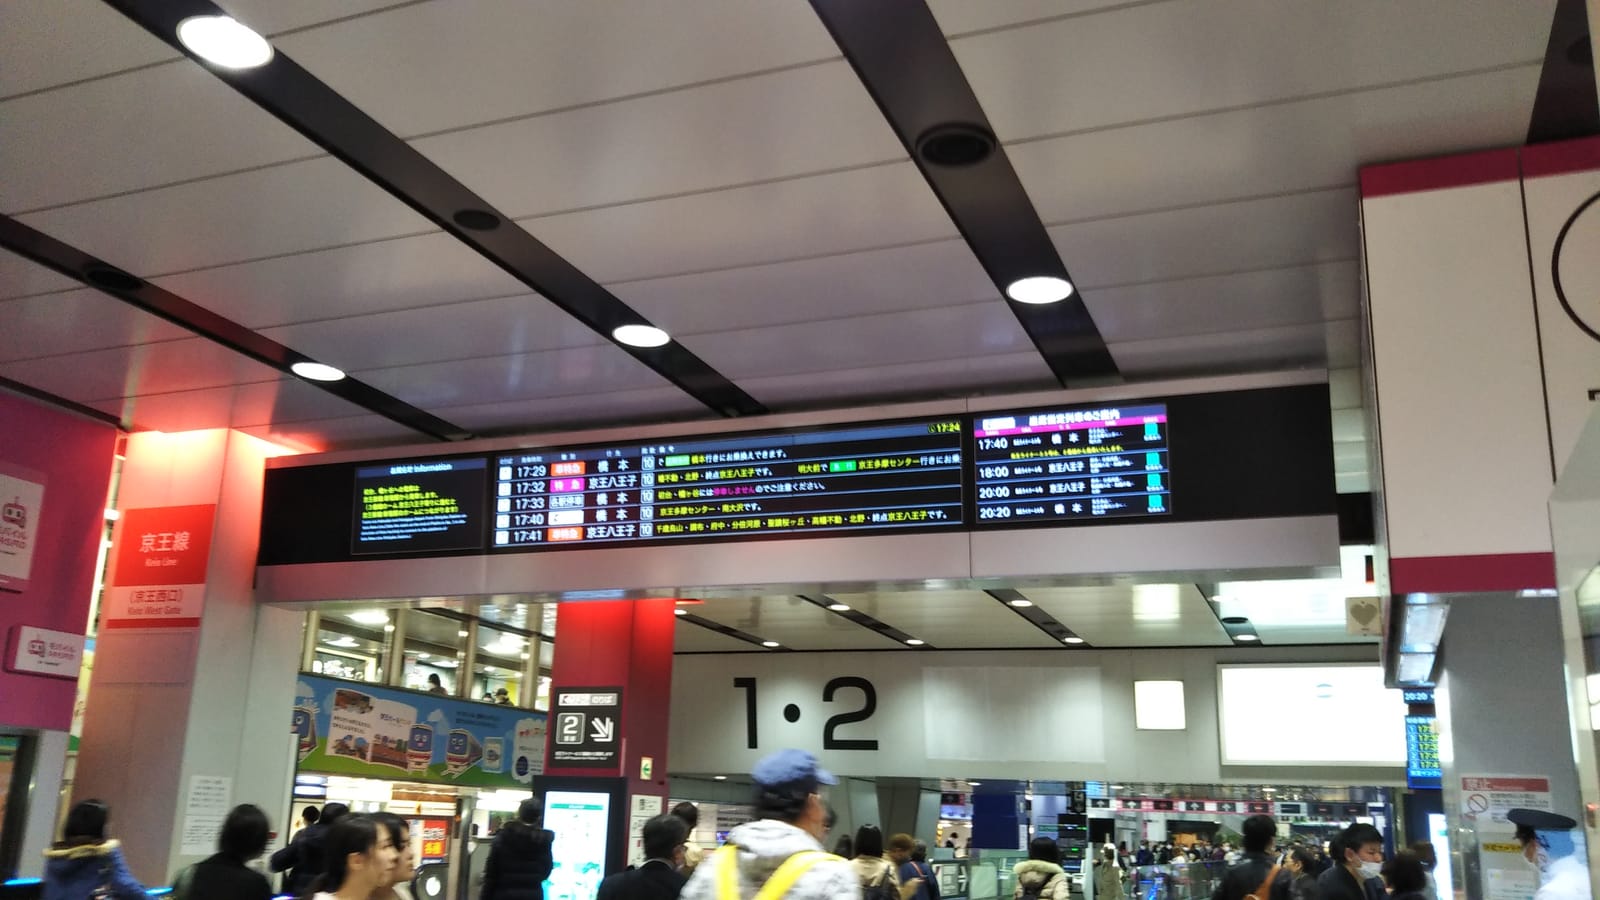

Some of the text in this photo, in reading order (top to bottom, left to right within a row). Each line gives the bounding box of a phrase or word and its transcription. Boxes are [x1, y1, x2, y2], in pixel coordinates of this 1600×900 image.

[978, 438, 1008, 450] 17:40
[517, 465, 547, 478] 17:29
[598, 459, 629, 474] 橋本
[979, 466, 1009, 478] 18:00
[516, 481, 545, 494] 17:32
[588, 475, 637, 490] 京王八王子
[597, 492, 628, 506] 橋本
[979, 486, 1010, 499] 20:00
[516, 497, 545, 510] 17:33
[596, 508, 628, 522] 橋本
[980, 506, 1011, 519] 20:20
[515, 513, 544, 526] 17:40
[514, 530, 543, 542] 17:41
[586, 524, 636, 539] 京王八王子
[139, 531, 190, 553] 京王線
[563, 716, 578, 734] 2
